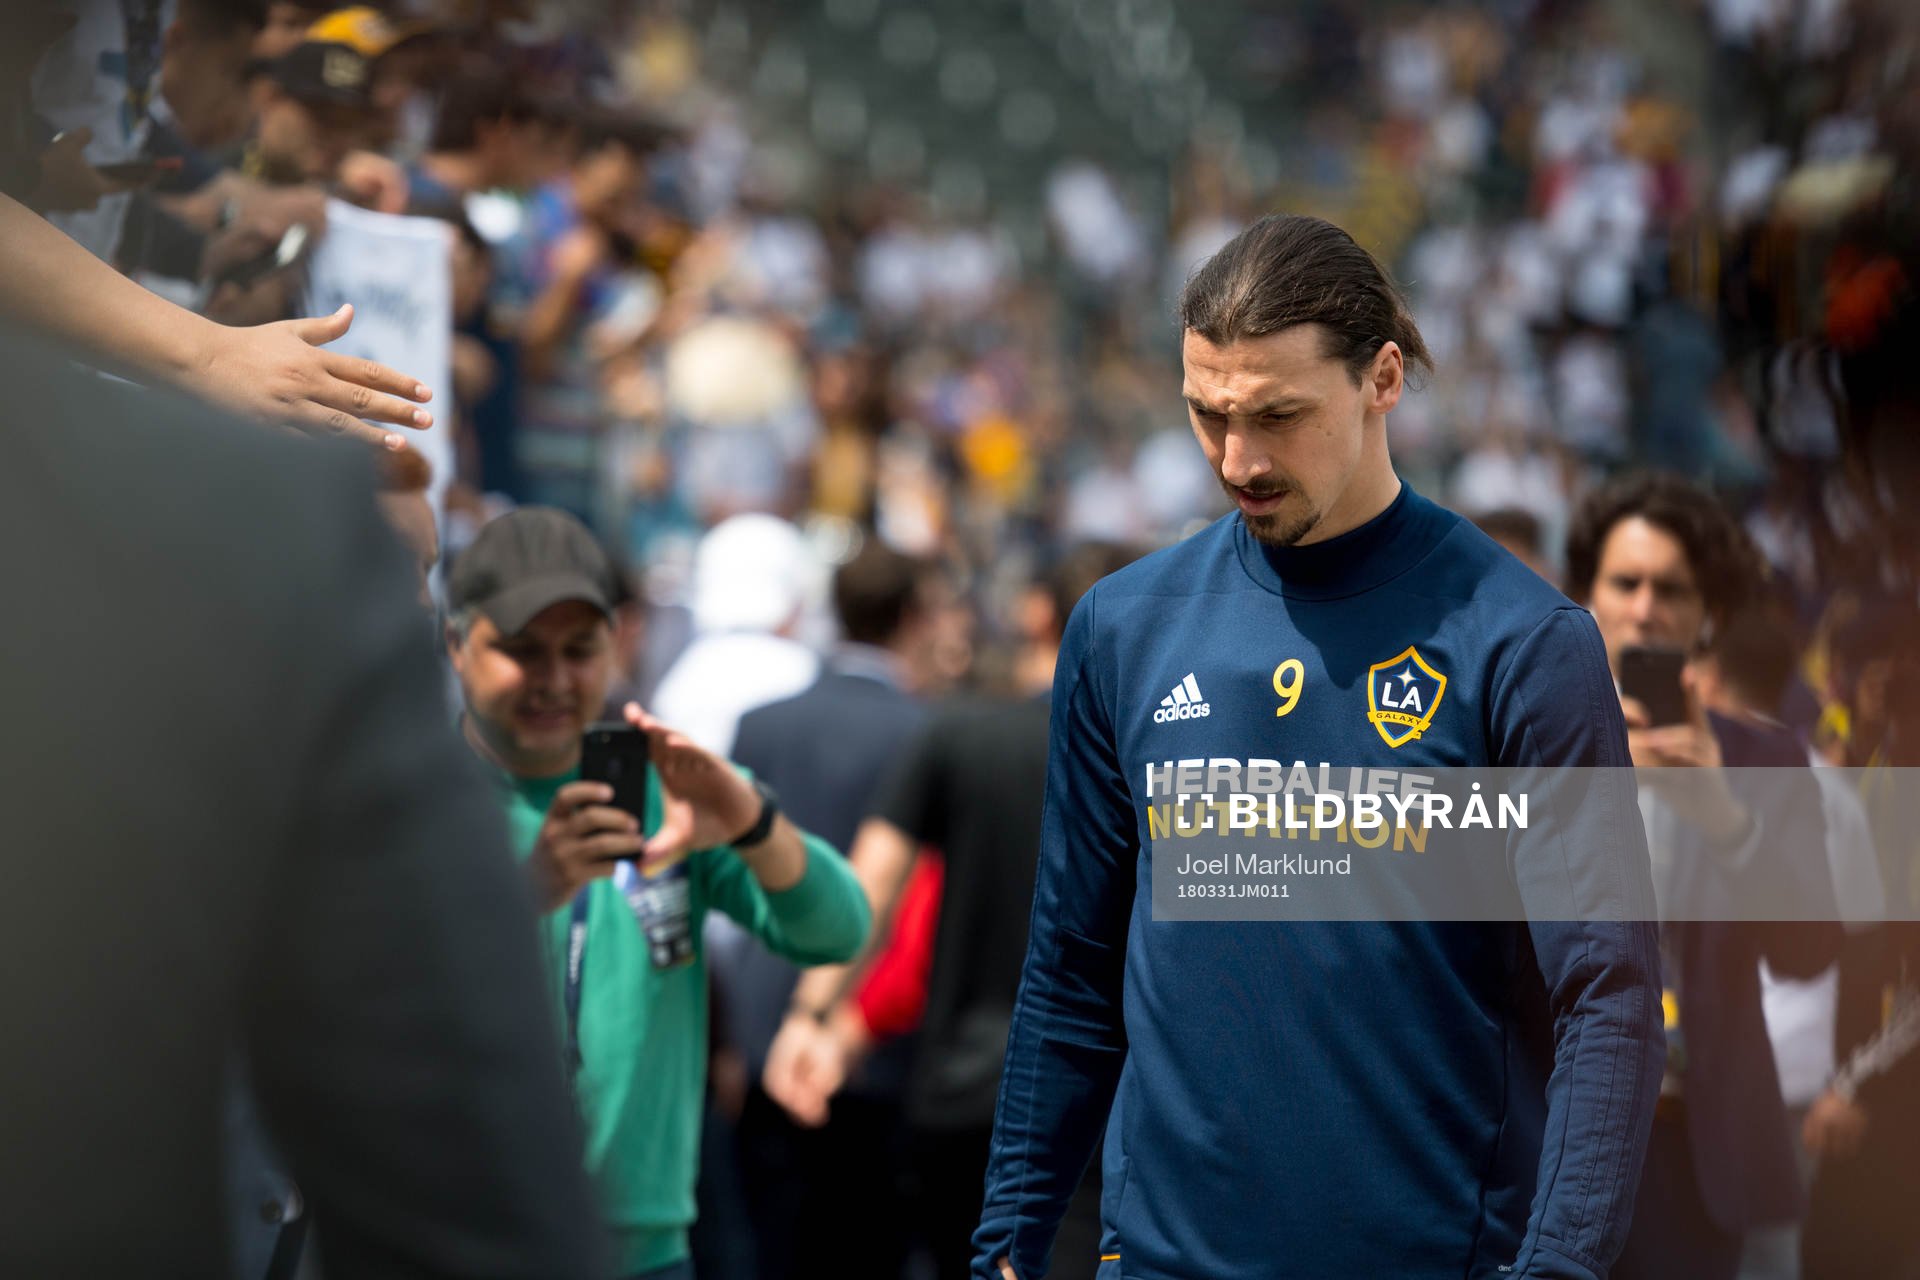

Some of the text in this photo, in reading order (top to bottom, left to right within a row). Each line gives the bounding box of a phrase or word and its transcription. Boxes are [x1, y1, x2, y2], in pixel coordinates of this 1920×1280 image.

[1272, 658, 1305, 717] 9
[1382, 682, 1423, 713] LA
[1153, 701, 1210, 724] adidas
[1376, 712, 1423, 726] GALAXY
[1146, 758, 1435, 810] HERBALIFE
